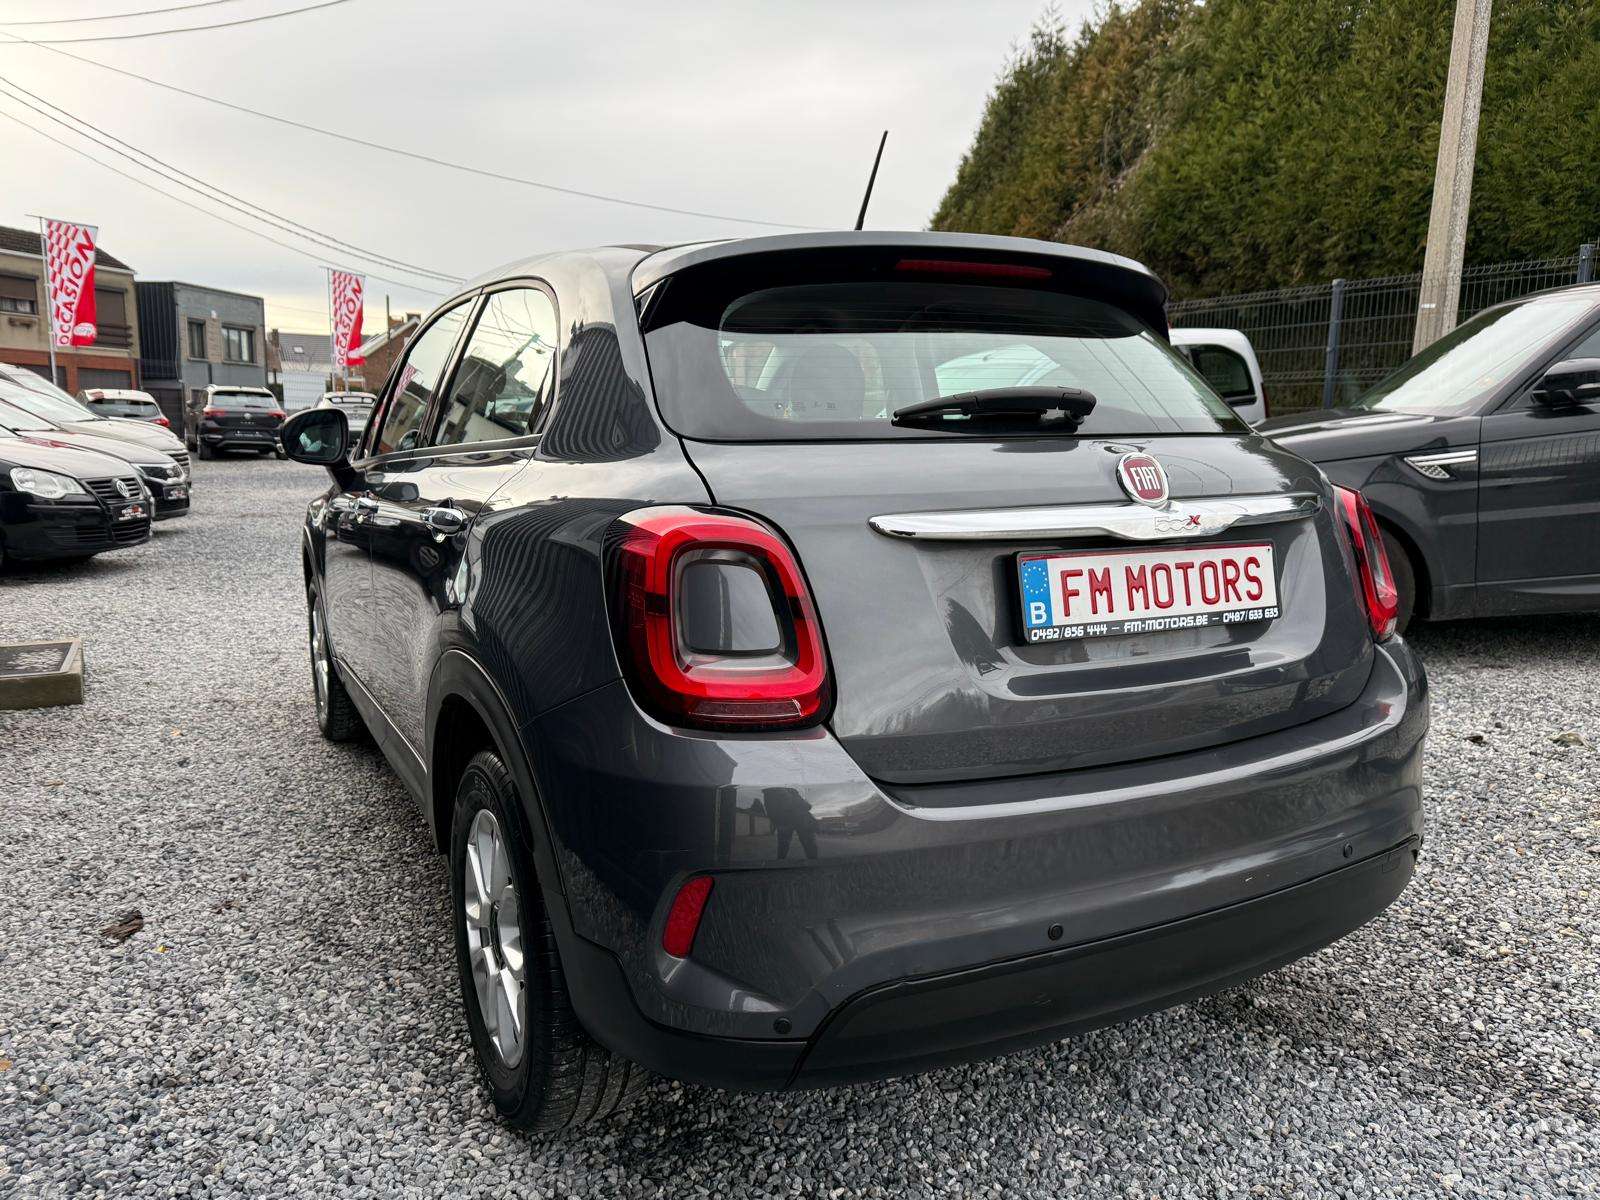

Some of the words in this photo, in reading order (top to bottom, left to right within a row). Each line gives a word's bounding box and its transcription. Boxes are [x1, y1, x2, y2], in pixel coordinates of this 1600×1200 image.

[59, 227, 95, 345] OCCASION
[337, 276, 363, 366] OCCASION
[1129, 466, 1161, 491] FIAT
[1060, 566, 1114, 617] FM
[1125, 556, 1263, 612] MOTORS
[1030, 602, 1047, 625] B
[1031, 625, 1084, 641] 0492/856
[1086, 623, 1108, 636] 444
[1124, 614, 1208, 633] FM-MOTORS.BE
